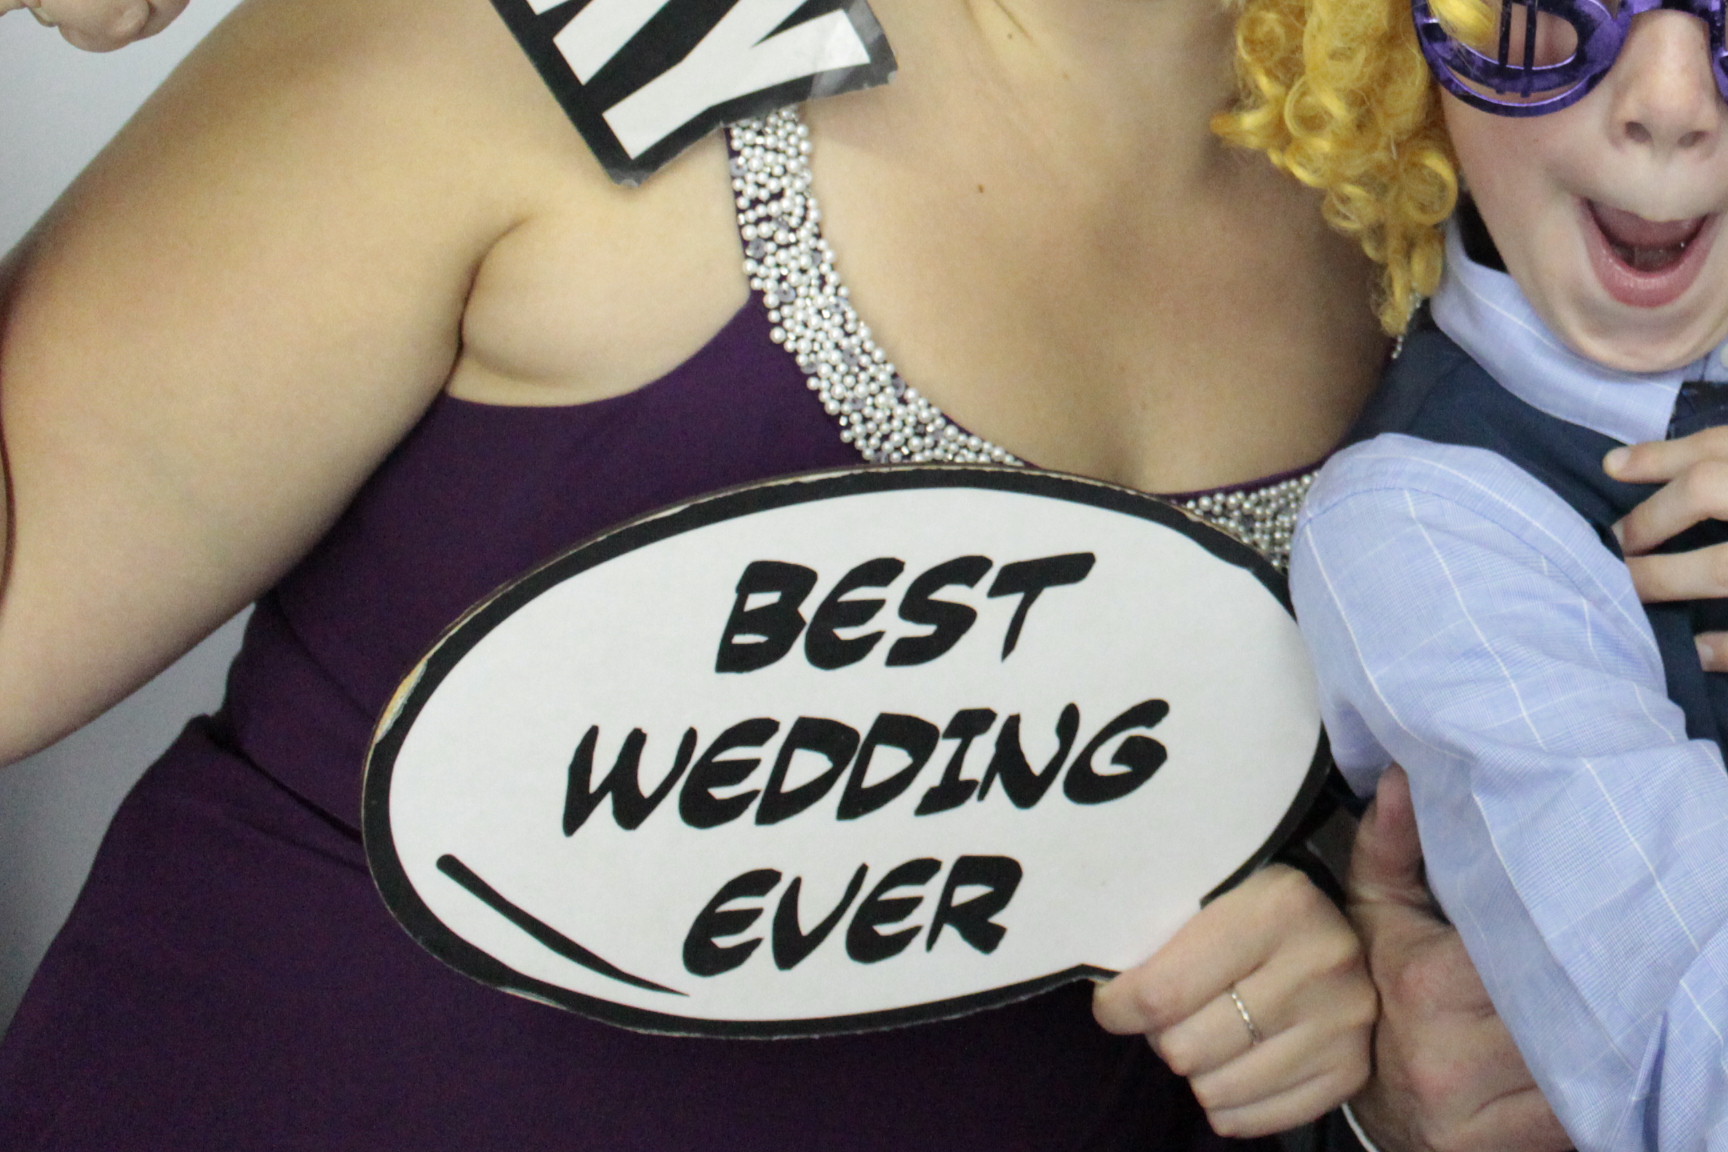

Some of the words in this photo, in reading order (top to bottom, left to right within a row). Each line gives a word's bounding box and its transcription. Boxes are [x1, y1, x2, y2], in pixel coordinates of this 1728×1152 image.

[716, 552, 1095, 673] BEST
[562, 699, 1169, 837] WEDDING
[682, 855, 1023, 977] EVER
